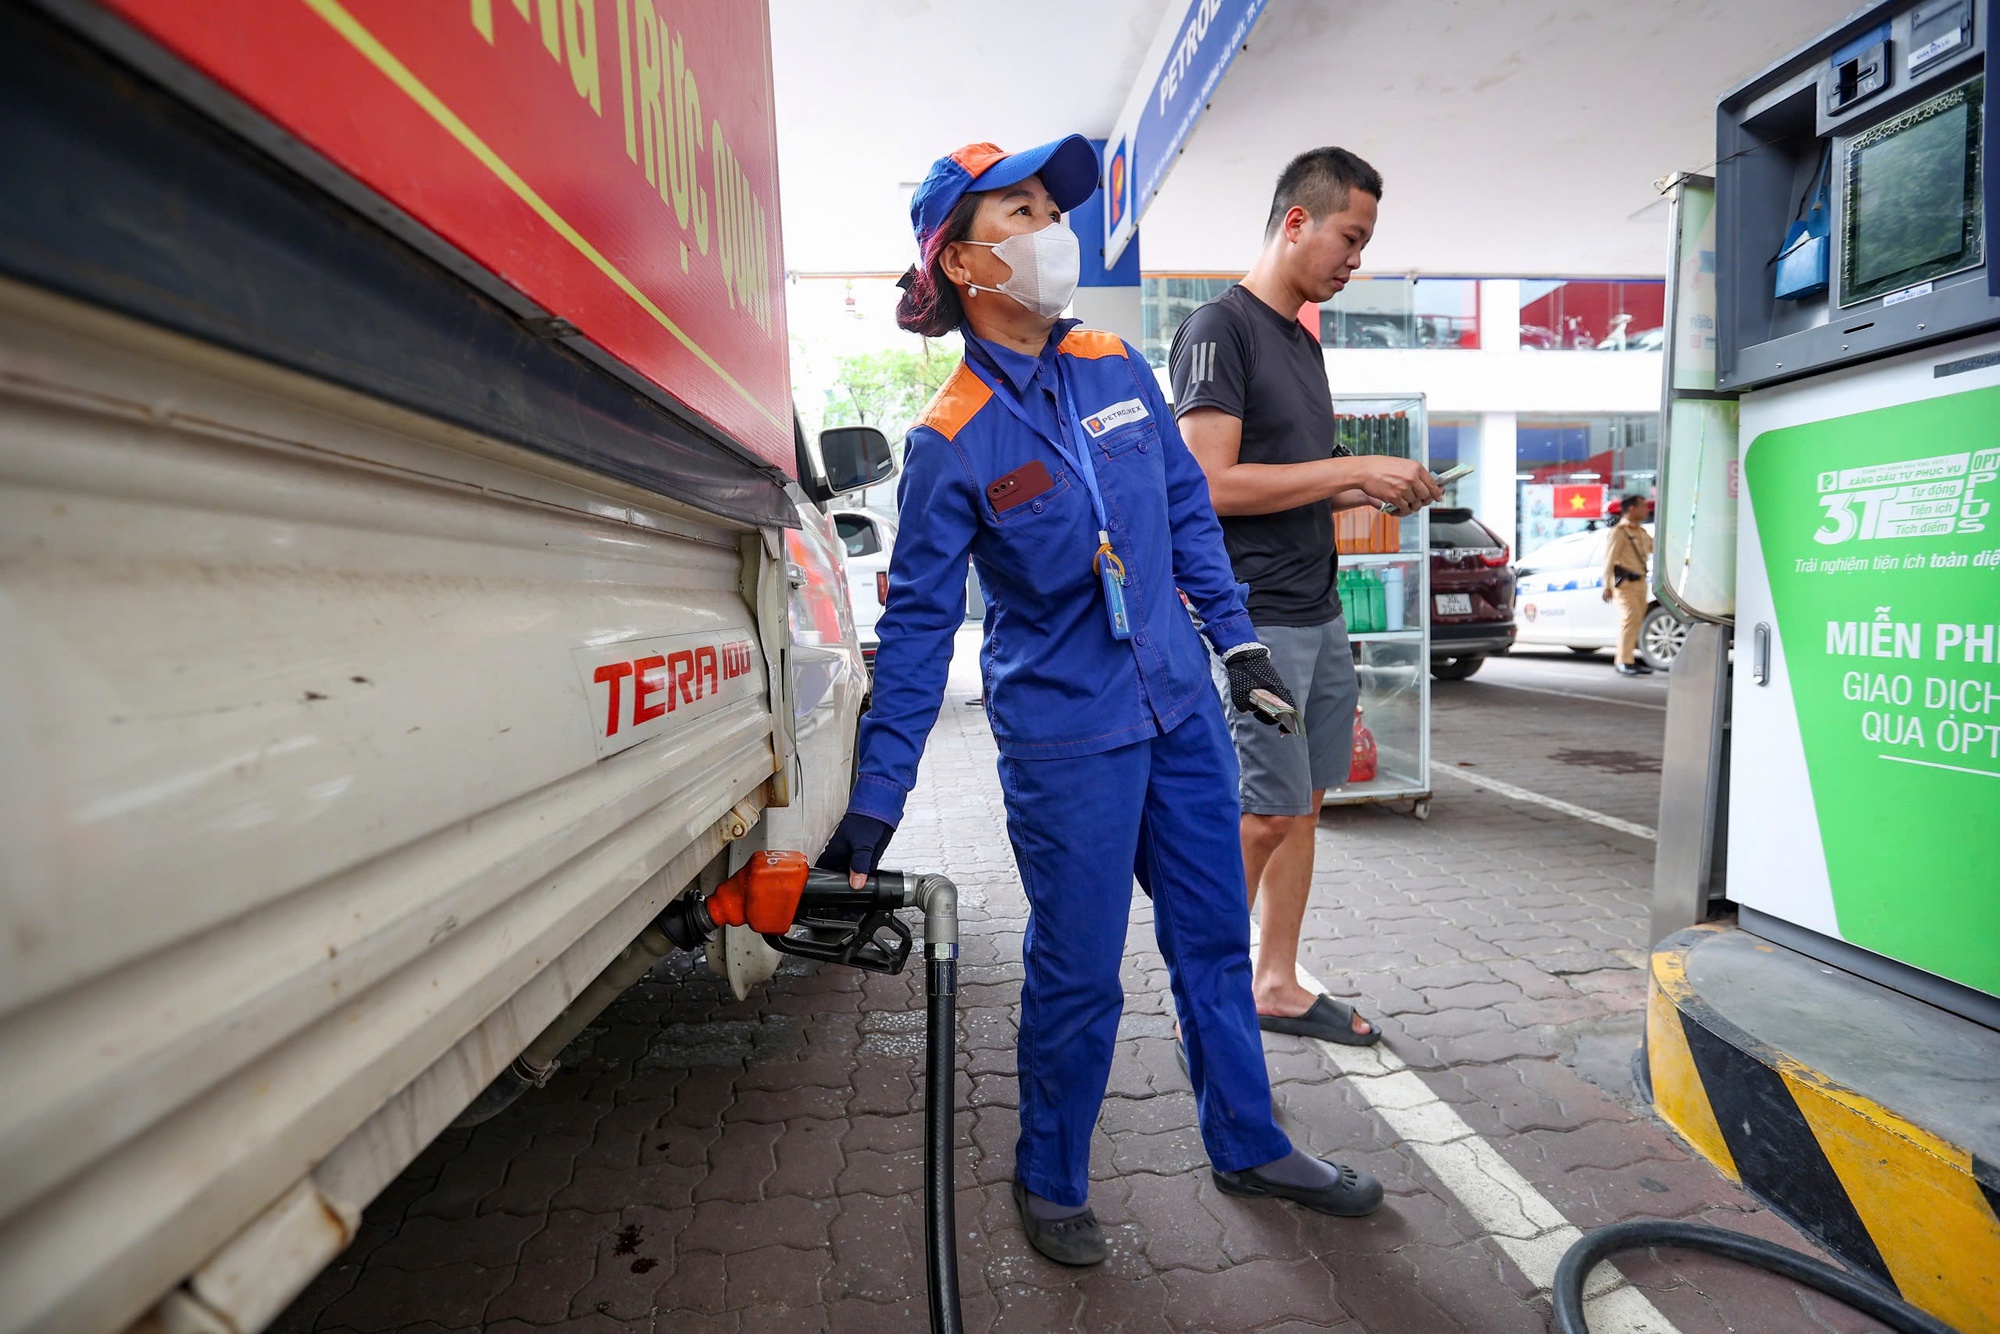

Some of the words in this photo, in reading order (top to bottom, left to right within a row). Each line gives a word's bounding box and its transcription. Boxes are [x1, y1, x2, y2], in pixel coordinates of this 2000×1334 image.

[1973, 453, 2000, 471] OPT
[1813, 486, 1898, 545] 3T
[1956, 472, 1998, 534] PLUS
[1795, 557, 1818, 573] Trải
[1820, 556, 1869, 575] nghiệm
[1873, 554, 1899, 574] tiện
[1902, 553, 1925, 569] ích
[1826, 605, 1921, 659] MIỄN
[594, 645, 717, 738] TERA
[722, 639, 751, 681] 100
[1842, 671, 1913, 706] GIAO
[1924, 677, 2000, 719] DỊCH
[1861, 710, 1925, 748] QUA
